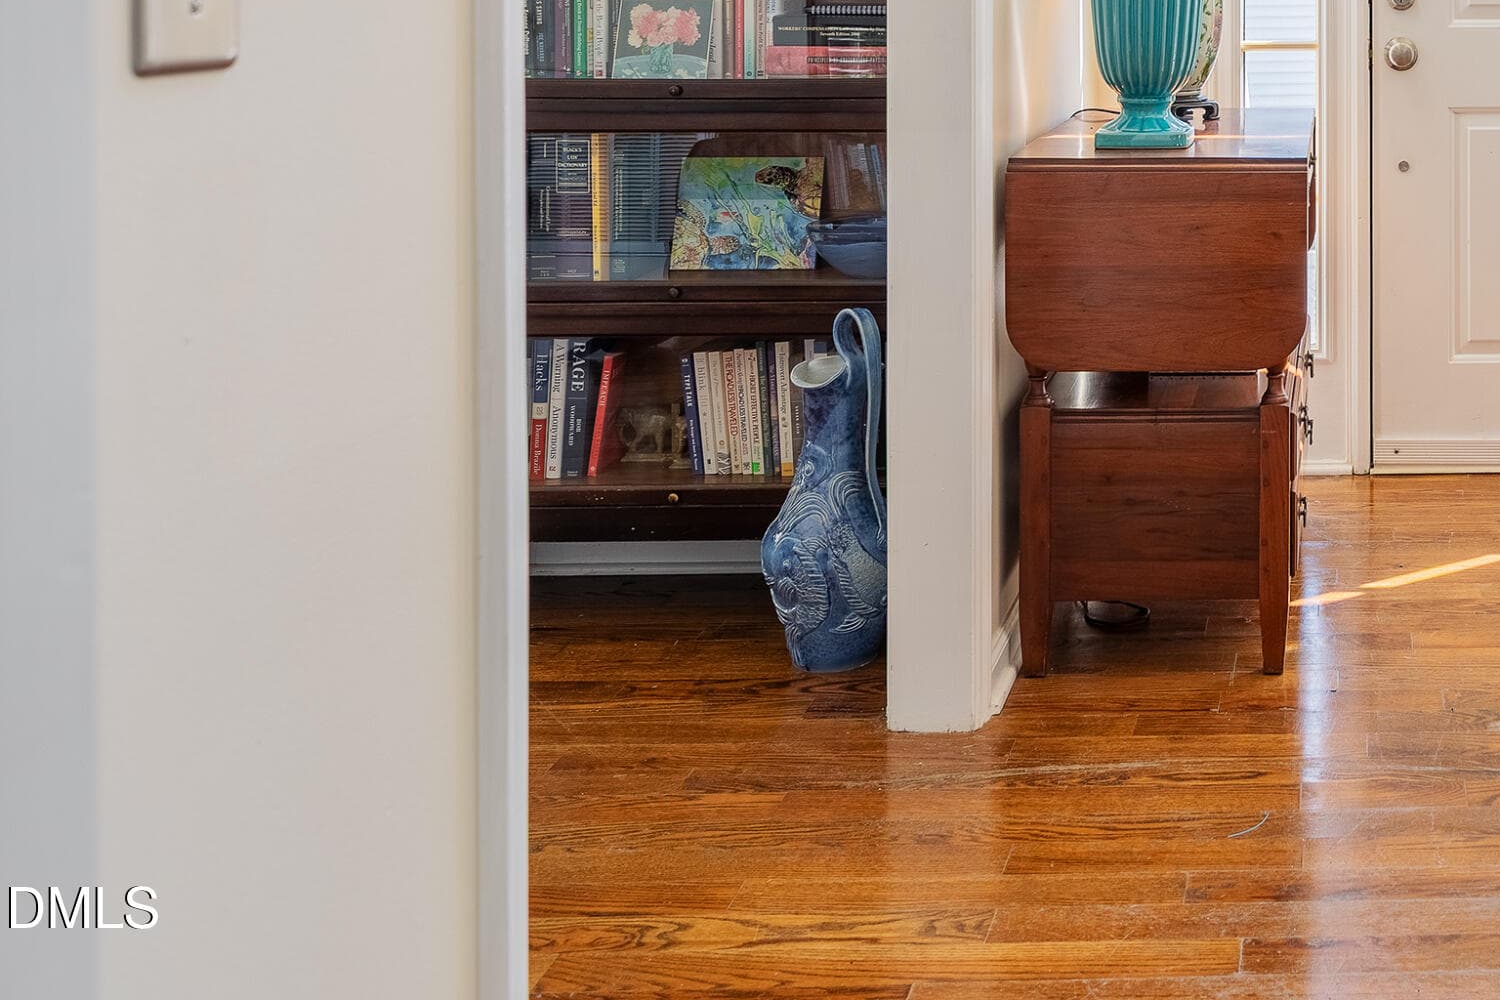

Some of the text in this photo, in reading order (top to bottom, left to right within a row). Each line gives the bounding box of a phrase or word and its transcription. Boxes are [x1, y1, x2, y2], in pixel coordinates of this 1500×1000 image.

[594, 37, 604, 59] People
[535, 354, 548, 391] Hacks
[552, 354, 565, 392] Warning
[571, 342, 587, 392] RAGE
[726, 369, 734, 389] ROAD
[599, 369, 610, 408] IMPEACH
[683, 374, 693, 407] TYPE TALK
[727, 389, 735, 403] LESS
[549, 406, 561, 460] Anonymous
[728, 403, 738, 436] TRAVELED
